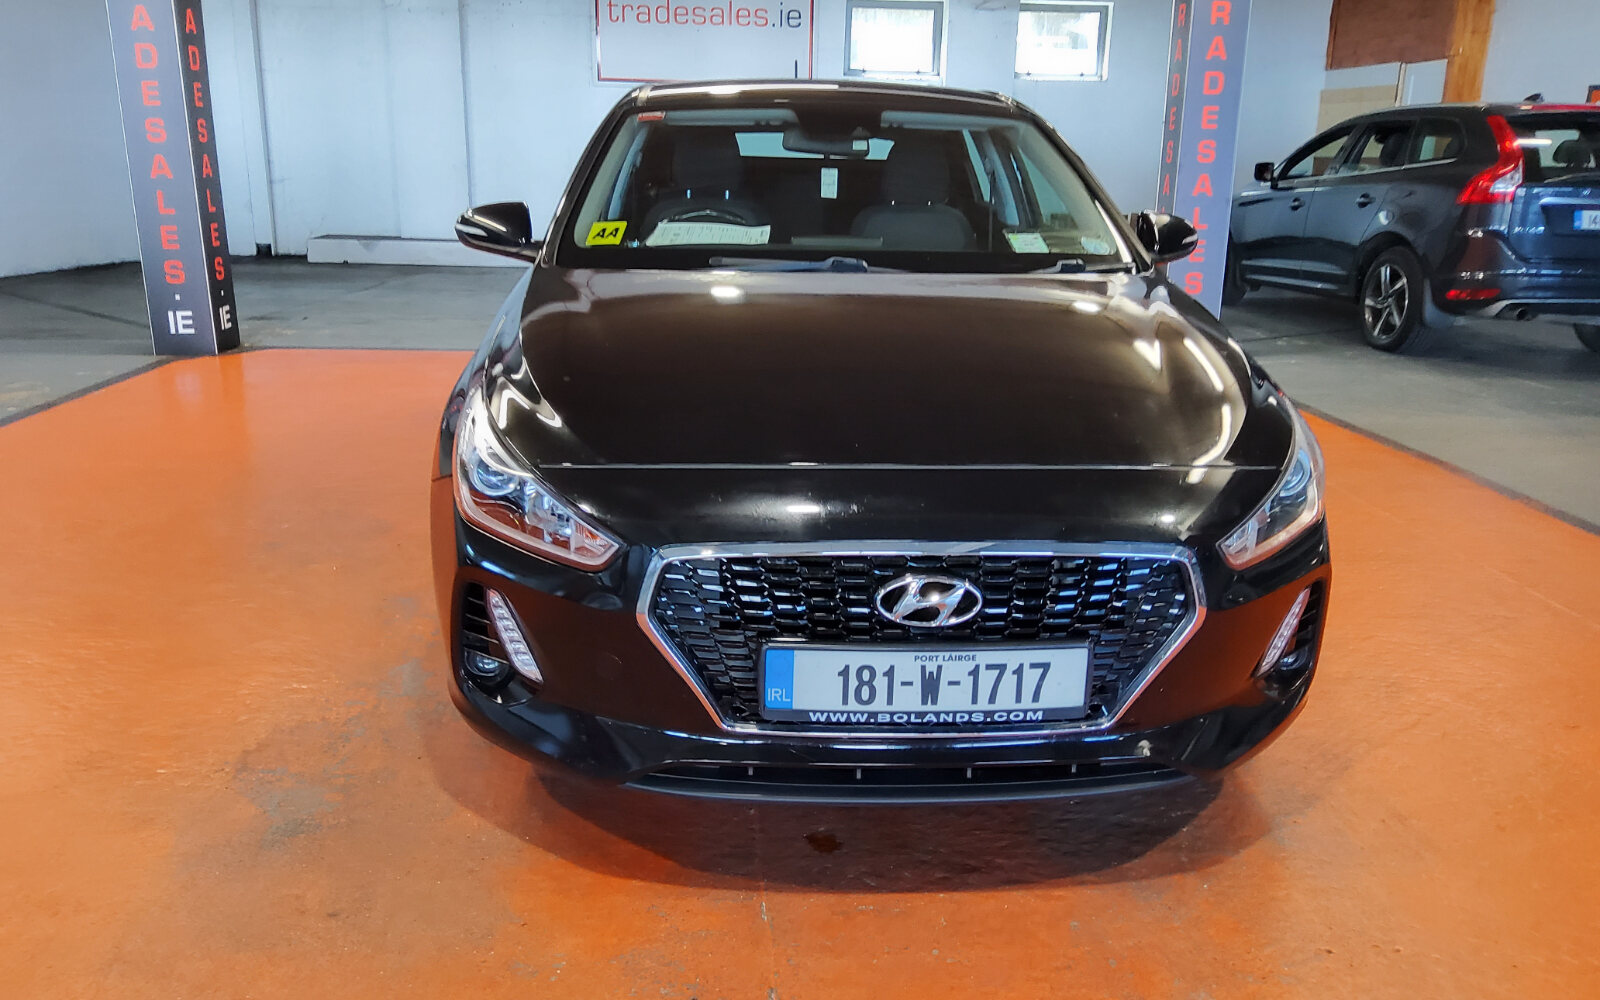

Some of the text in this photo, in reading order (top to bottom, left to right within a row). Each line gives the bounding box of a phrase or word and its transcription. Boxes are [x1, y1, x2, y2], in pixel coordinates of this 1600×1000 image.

[606, 0, 802, 29] tradesales.ie
[592, 227, 620, 239] AA
[914, 654, 940, 663] PORT
[837, 662, 1051, 706] 181-W-1717
[767, 688, 791, 702] IRL
[809, 710, 1044, 724] WWW.BOLANDS.COM
